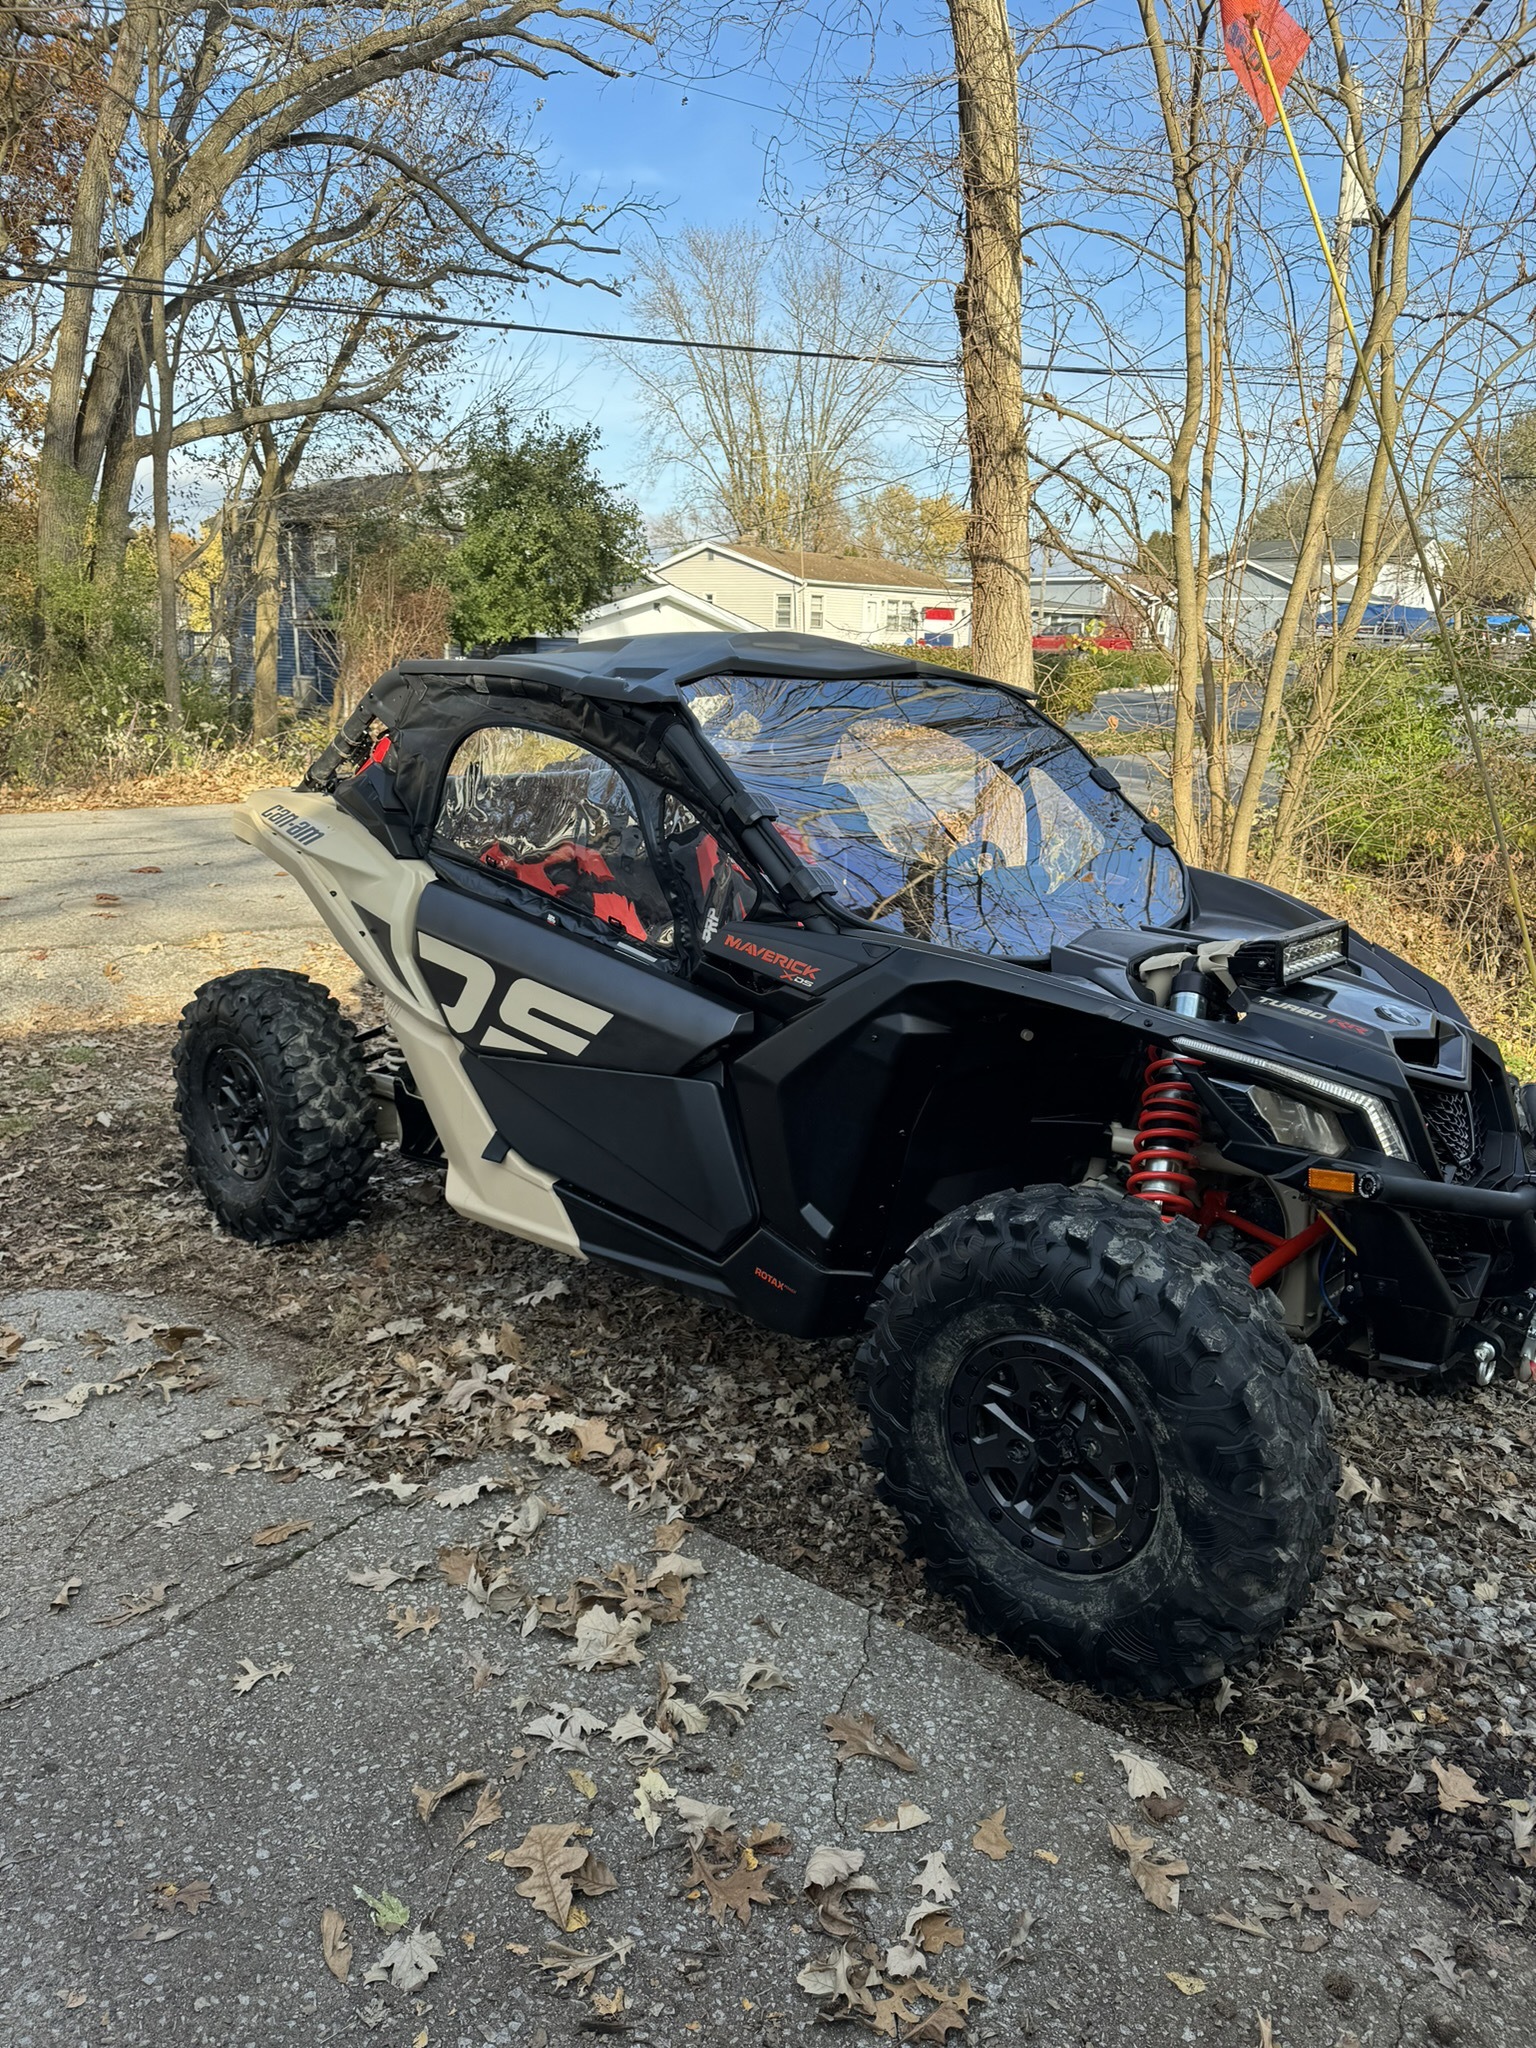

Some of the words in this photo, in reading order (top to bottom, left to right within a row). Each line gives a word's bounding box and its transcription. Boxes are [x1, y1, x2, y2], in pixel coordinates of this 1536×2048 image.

[702, 907, 720, 943] PRP
[724, 934, 821, 980] MAVERICK
[1258, 996, 1328, 1020] TURBO
[1327, 1017, 1369, 1035] RR
[754, 1266, 785, 1291] ROTAX
